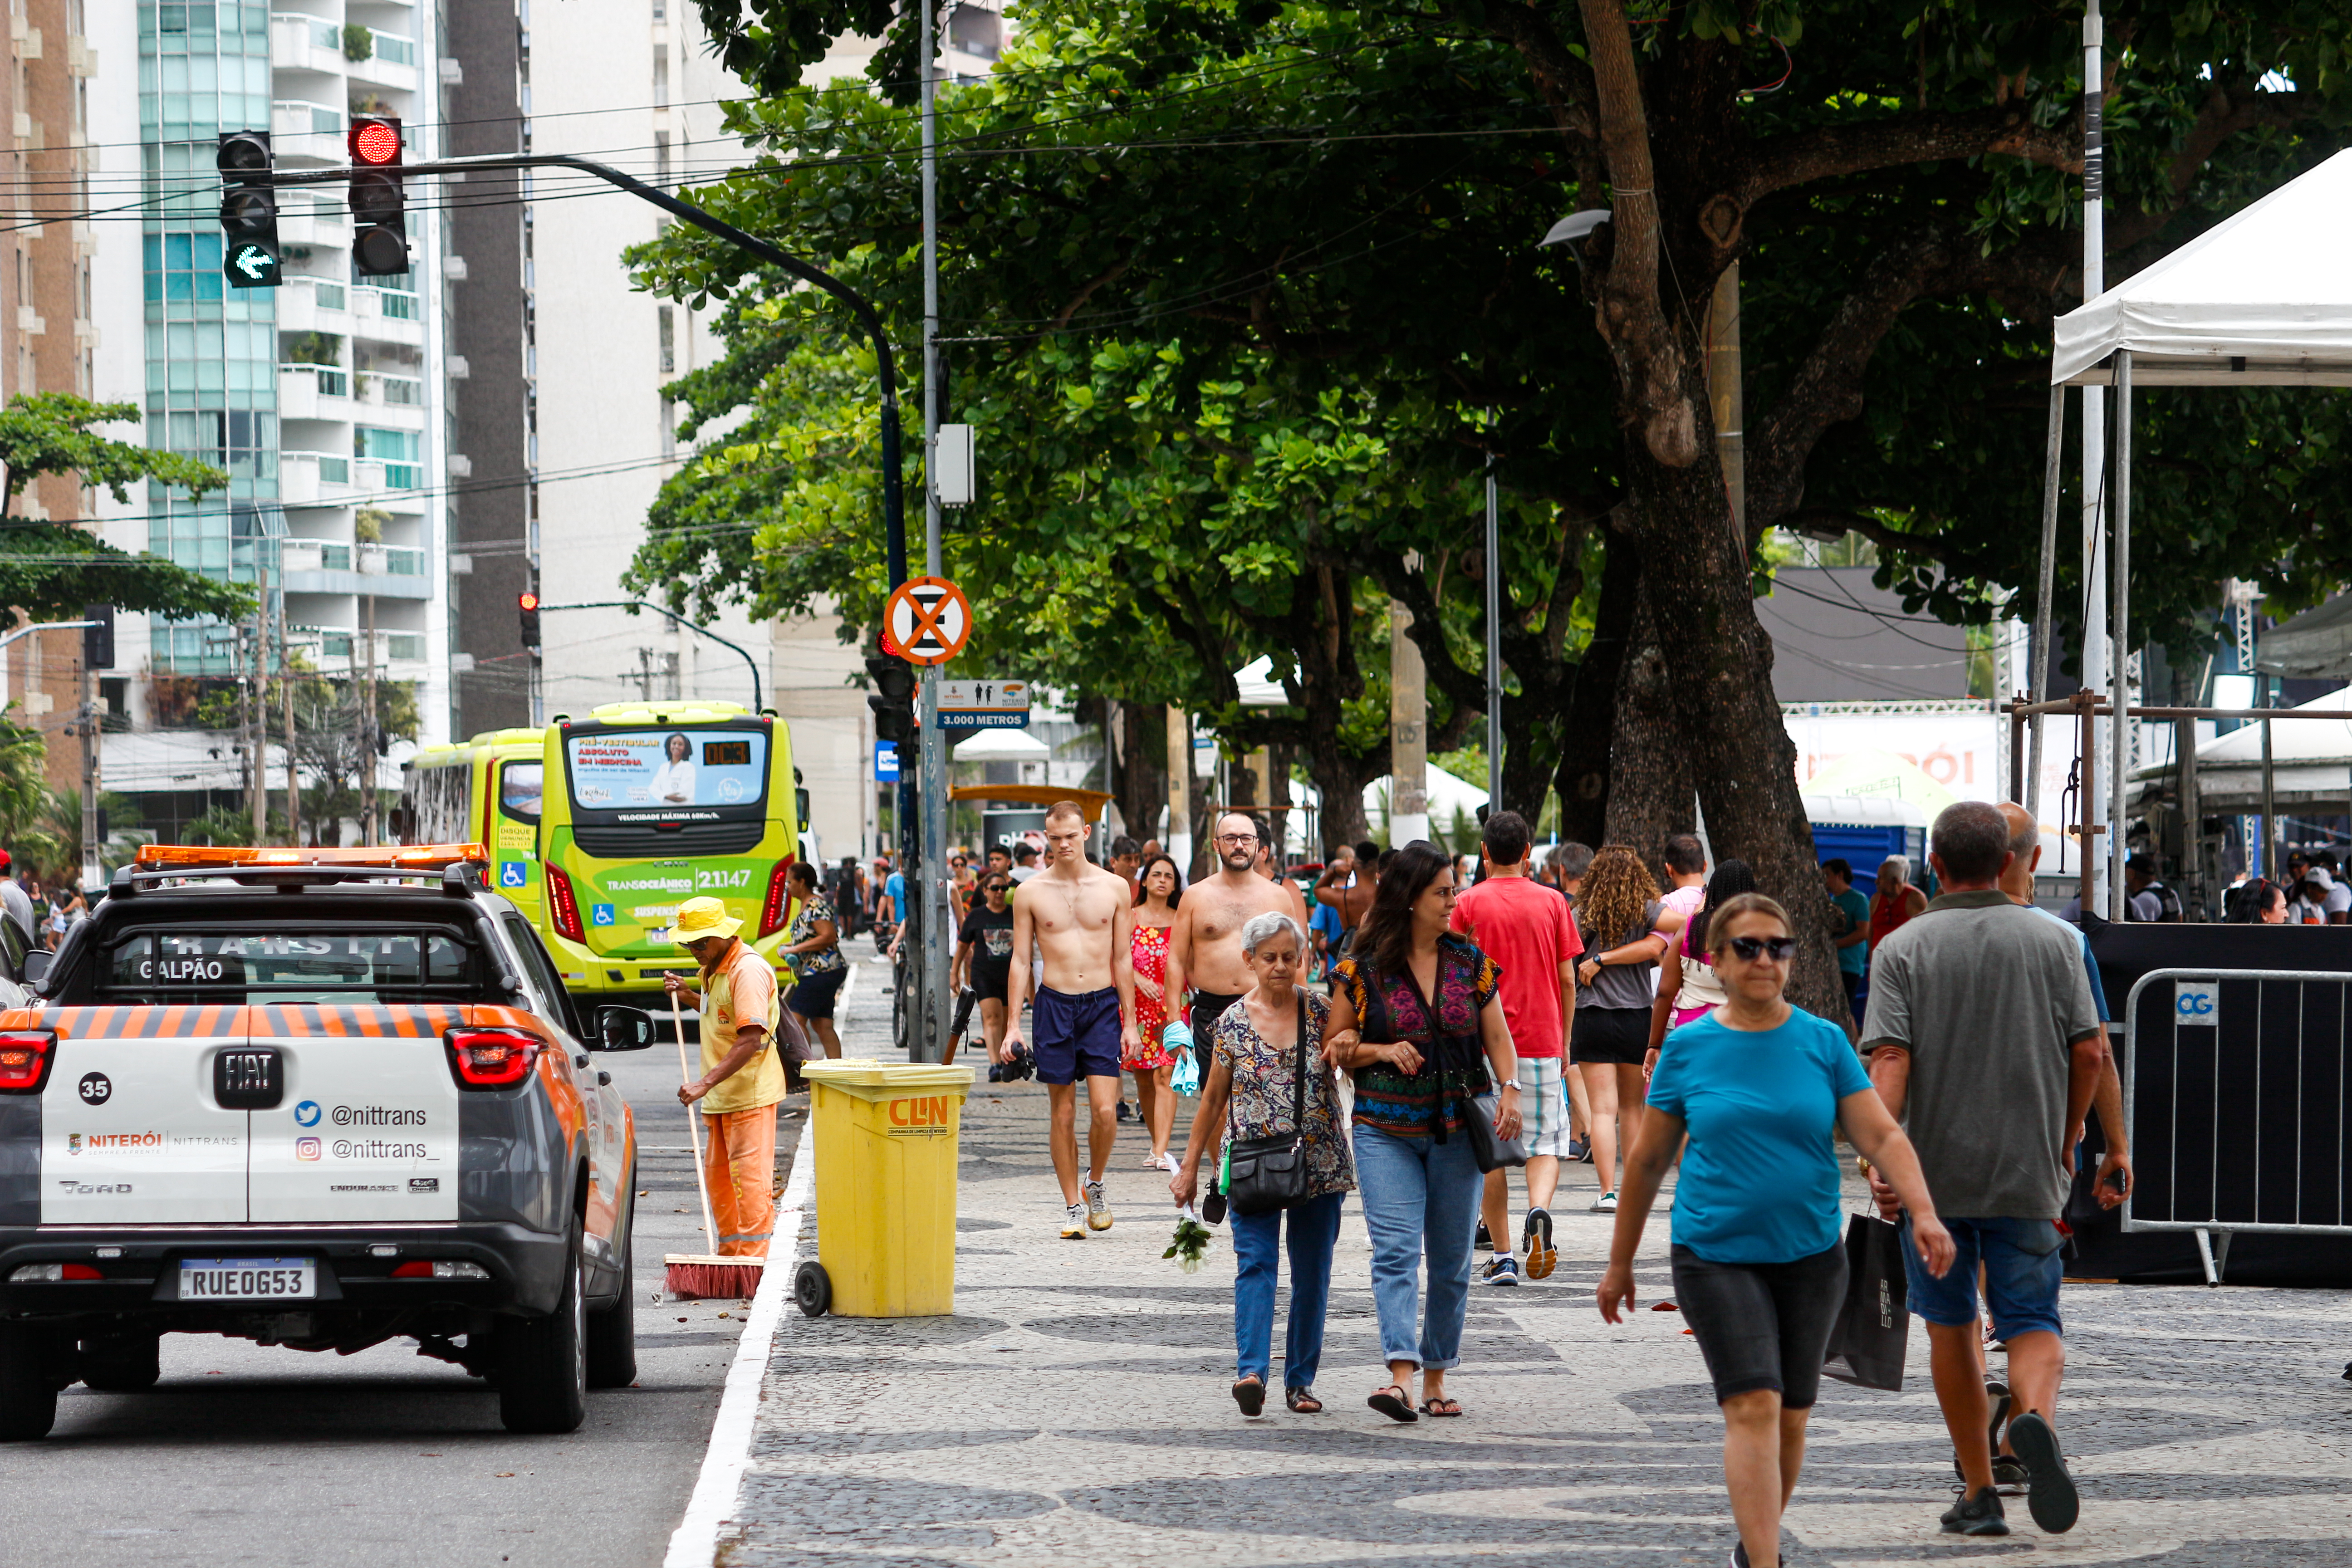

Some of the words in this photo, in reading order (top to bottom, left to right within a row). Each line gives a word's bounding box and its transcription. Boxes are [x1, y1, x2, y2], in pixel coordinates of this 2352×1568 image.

[943, 715, 974, 725] 3.000
[976, 715, 1022, 725] METROS
[618, 813, 660, 822] VELOCIDADE
[661, 811, 691, 820] MÁXIMA
[607, 877, 692, 891] TRANSOCEÂNICO
[139, 957, 222, 980] GALPÃO
[2176, 993, 2213, 1015] CG
[226, 1054, 272, 1090] FIAT
[82, 1081, 108, 1098] 35
[332, 1105, 426, 1126] @nittrans
[889, 1095, 947, 1126] CLIN
[88, 1130, 161, 1147] NITERÓI
[174, 1137, 238, 1146] NITTRANS
[1880, 1279, 1888, 1292] AR
[1880, 1291, 1891, 1305] MA
[1881, 1314, 1891, 1329] LLO
